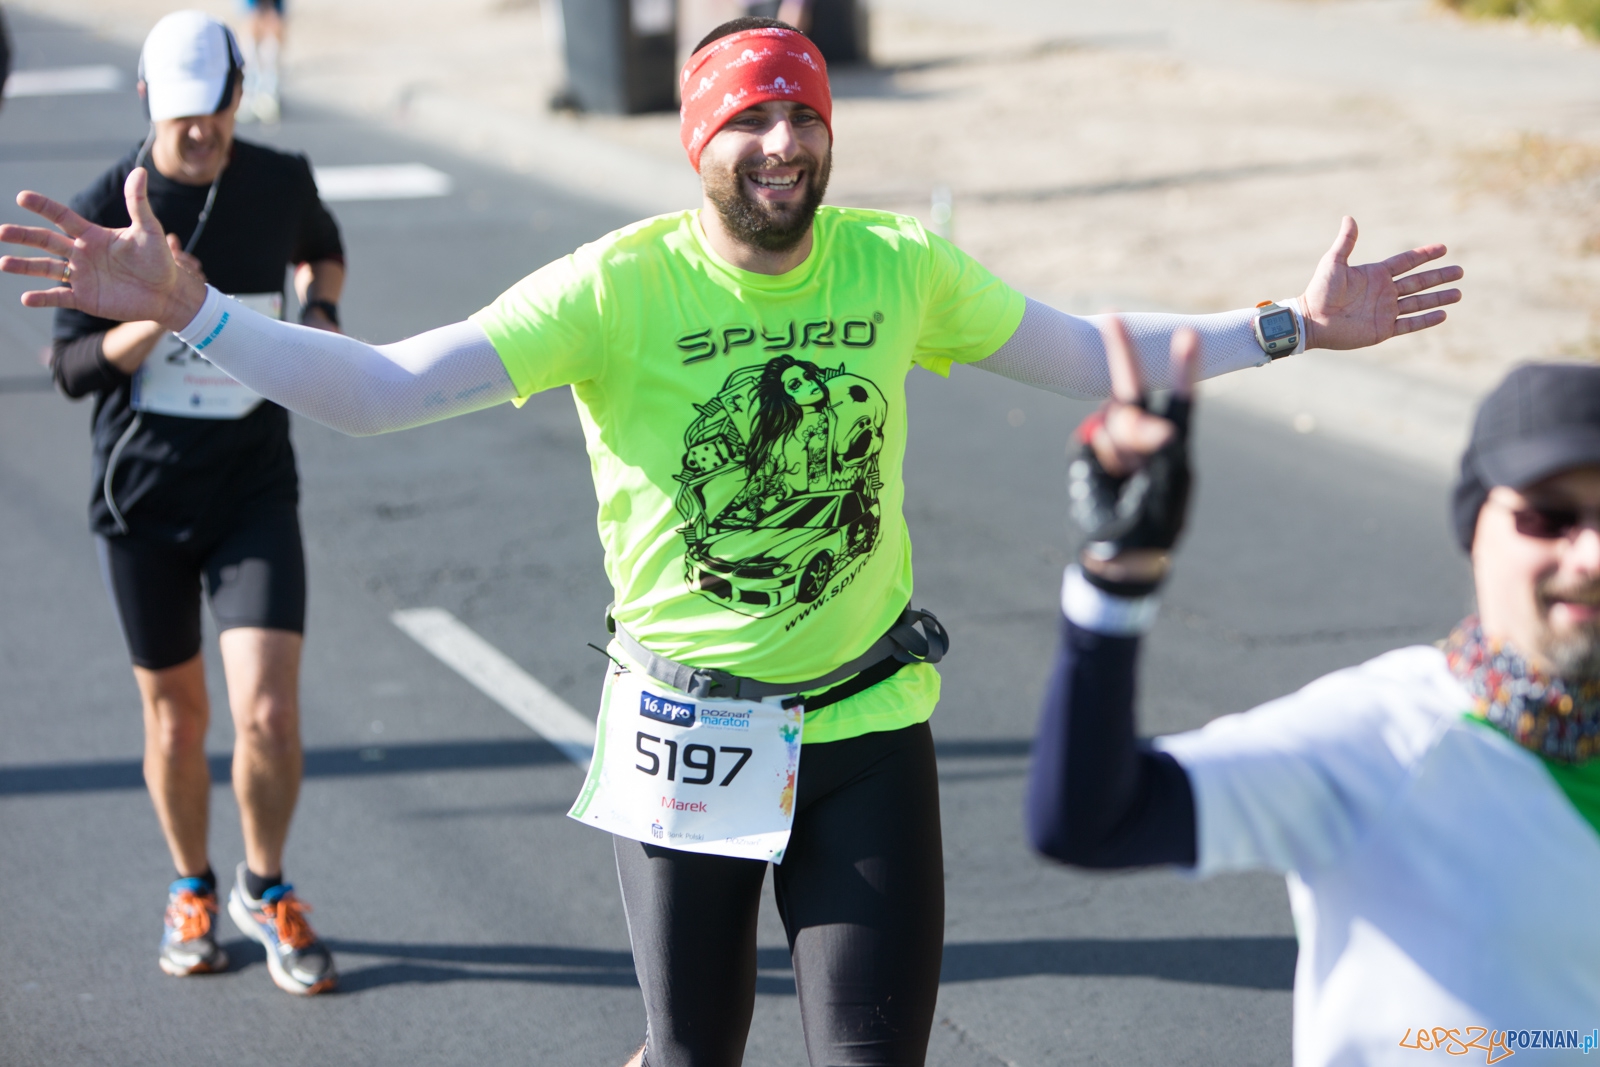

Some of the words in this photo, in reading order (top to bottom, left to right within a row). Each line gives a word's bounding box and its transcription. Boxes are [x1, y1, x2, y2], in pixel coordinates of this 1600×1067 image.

[643, 697, 661, 714] 16.
[662, 702, 690, 720] PKO
[700, 716, 749, 728] maraton
[635, 731, 753, 787] 5197
[661, 796, 707, 813] Marek
